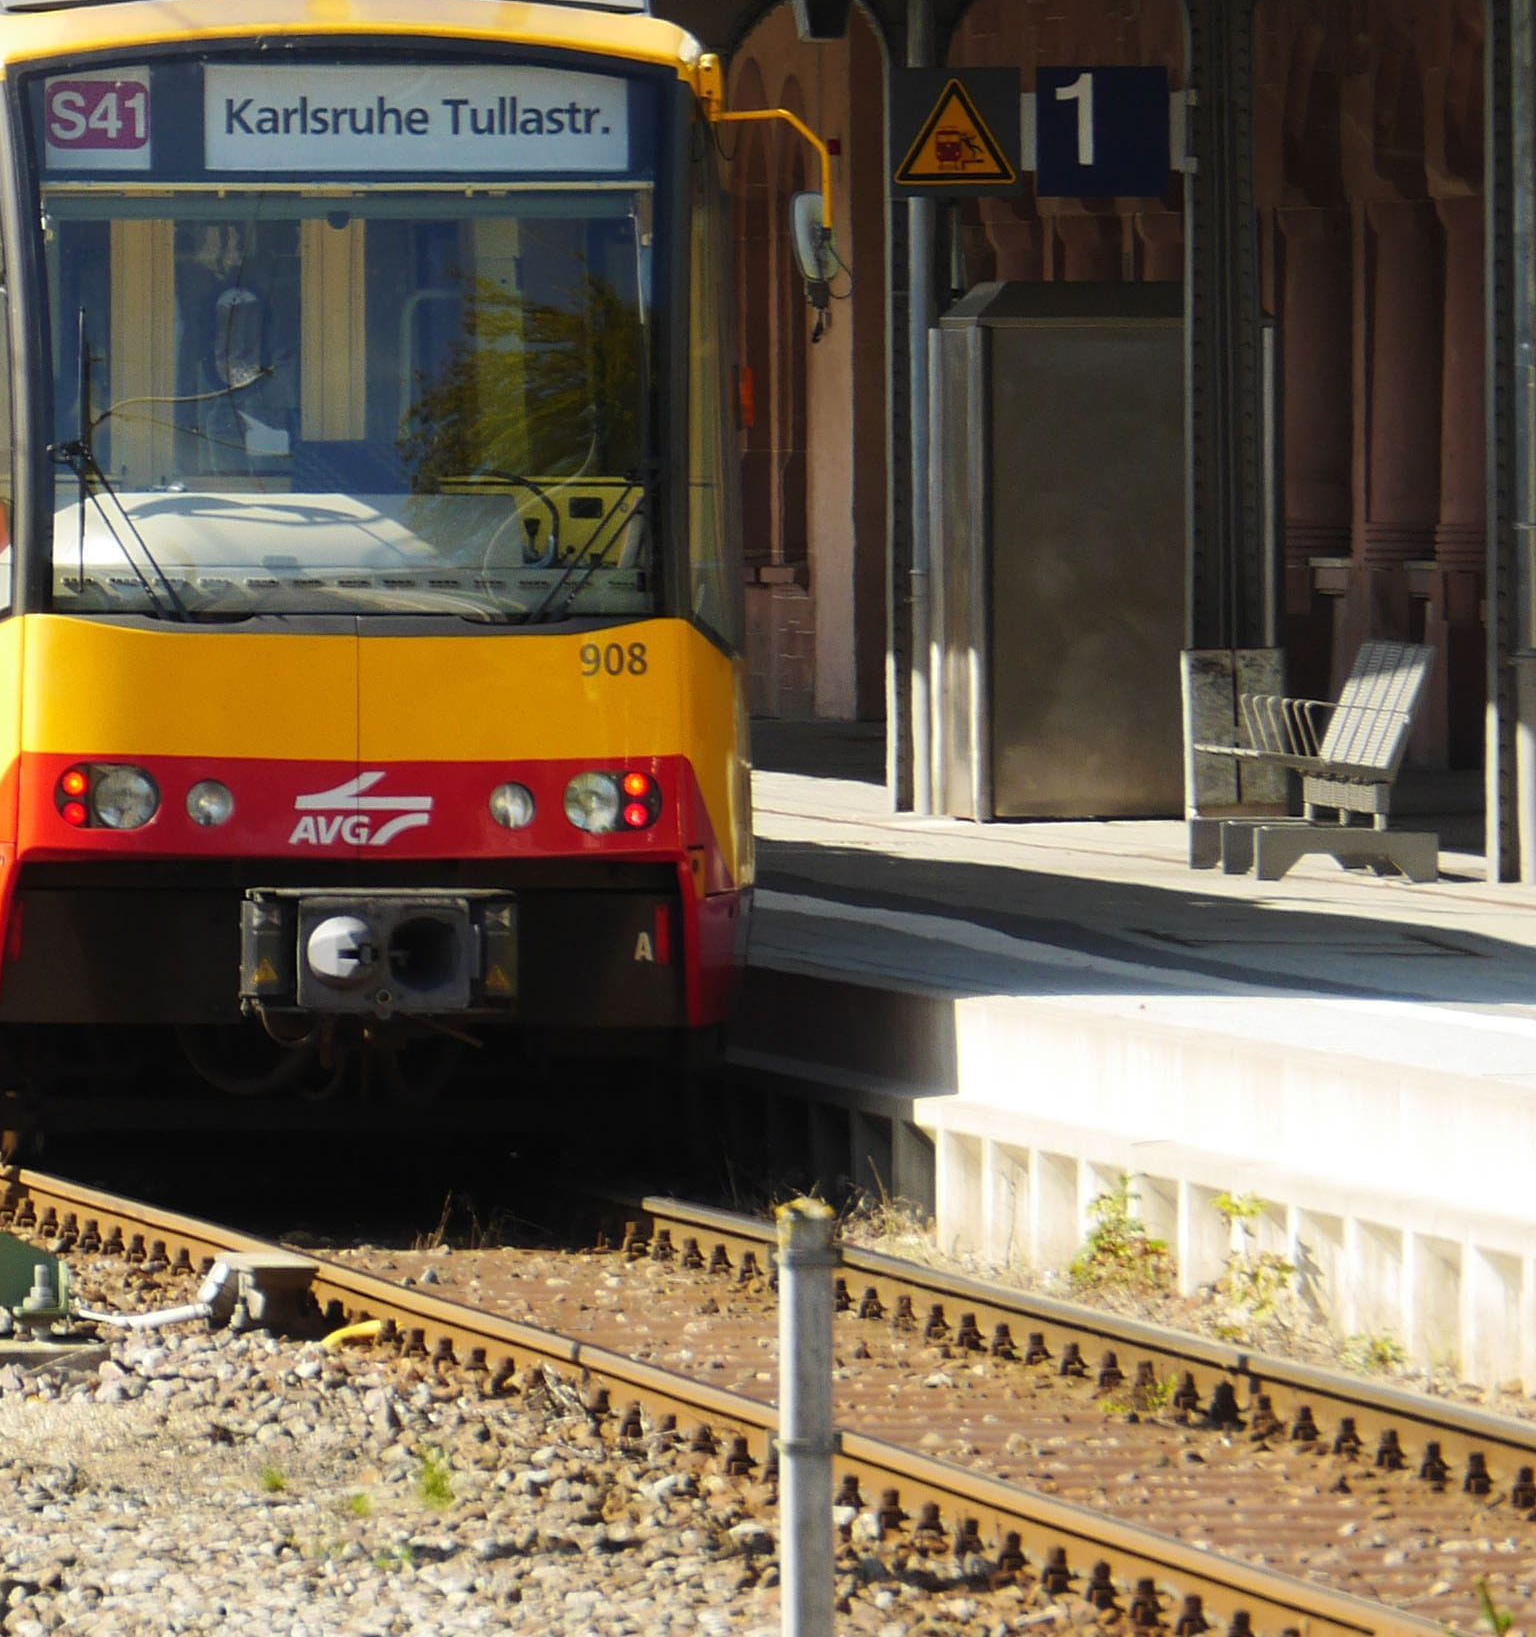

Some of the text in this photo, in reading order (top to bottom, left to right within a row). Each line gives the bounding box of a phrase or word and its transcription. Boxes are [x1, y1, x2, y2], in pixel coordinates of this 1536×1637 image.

[49, 90, 150, 141] S41
[224, 95, 611, 138] Karlsruhe Tullastr.
[1055, 72, 1095, 166] 1
[579, 640, 649, 678] 908
[288, 815, 371, 846] AVG
[634, 930, 655, 963] A
